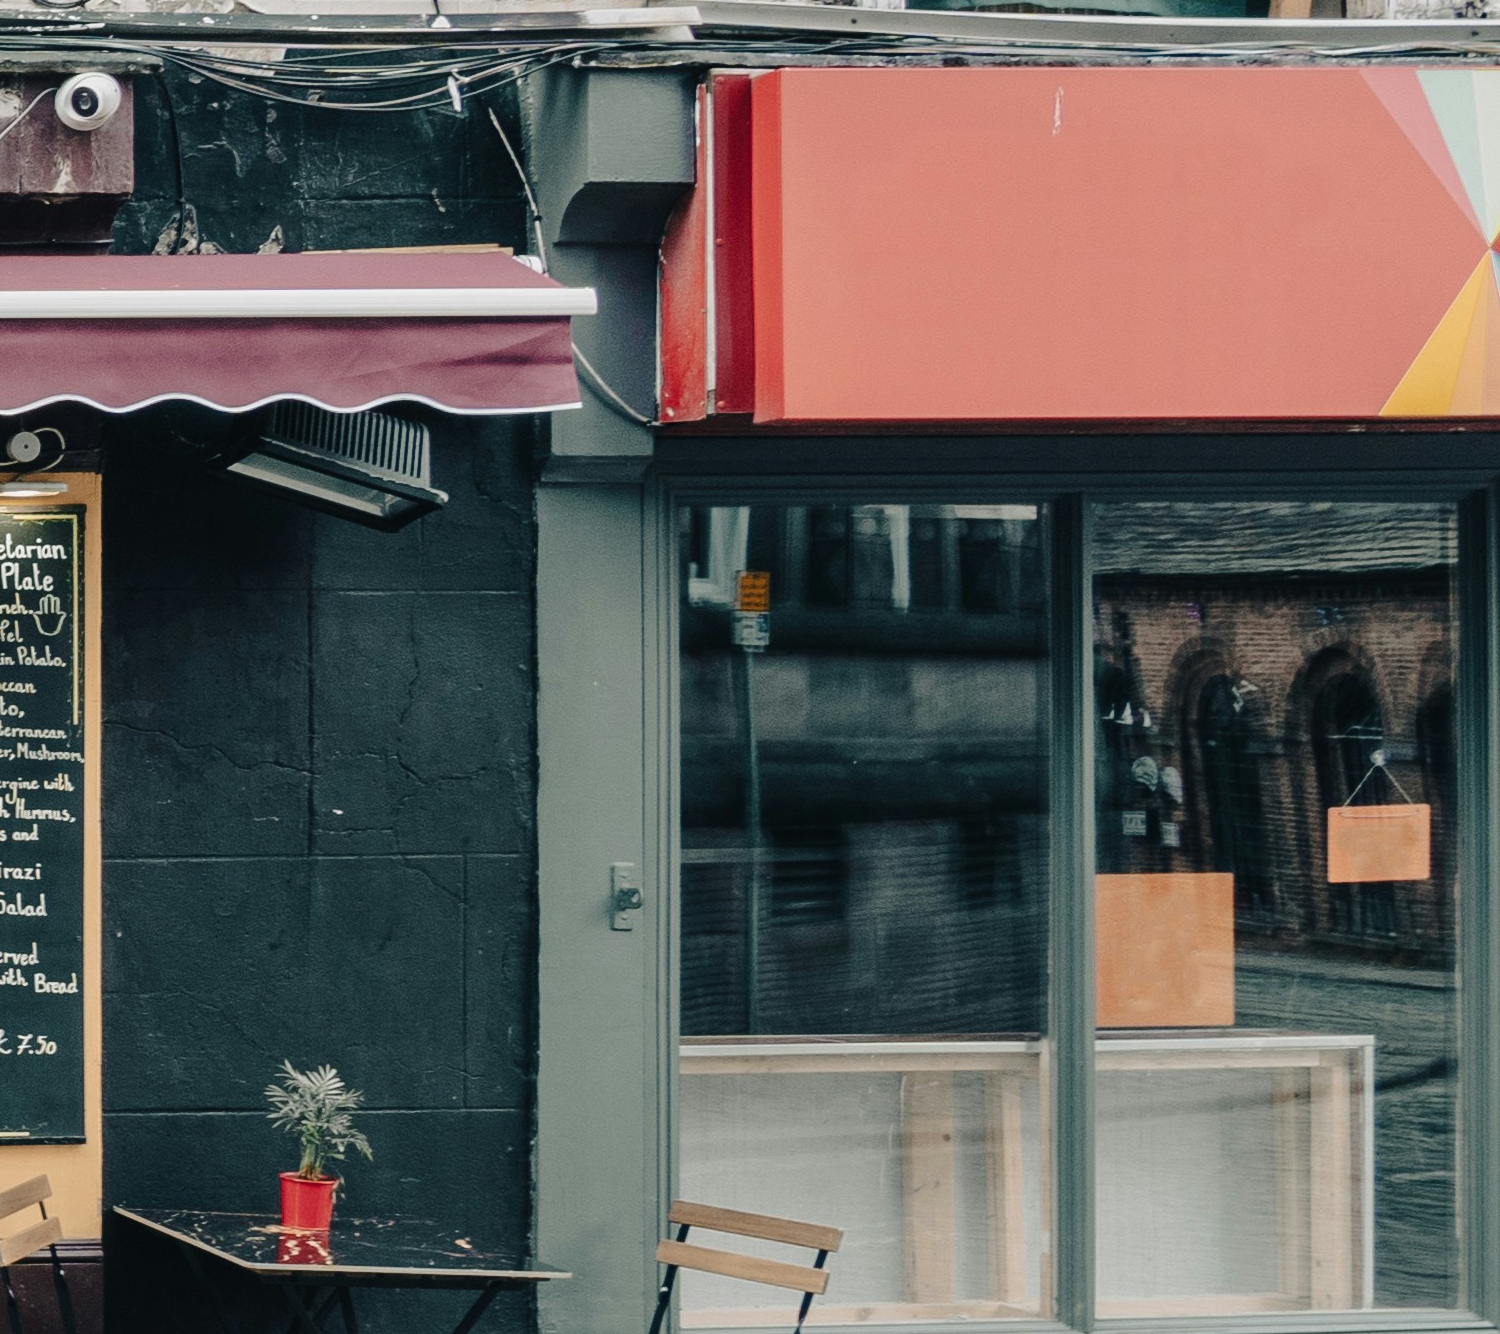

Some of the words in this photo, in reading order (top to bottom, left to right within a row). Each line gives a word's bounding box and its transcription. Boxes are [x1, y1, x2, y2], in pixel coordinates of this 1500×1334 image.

[1, 562, 54, 591] Plate
[44, 773, 74, 791] with
[12, 823, 39, 841] and
[34, 972, 78, 994] Bread
